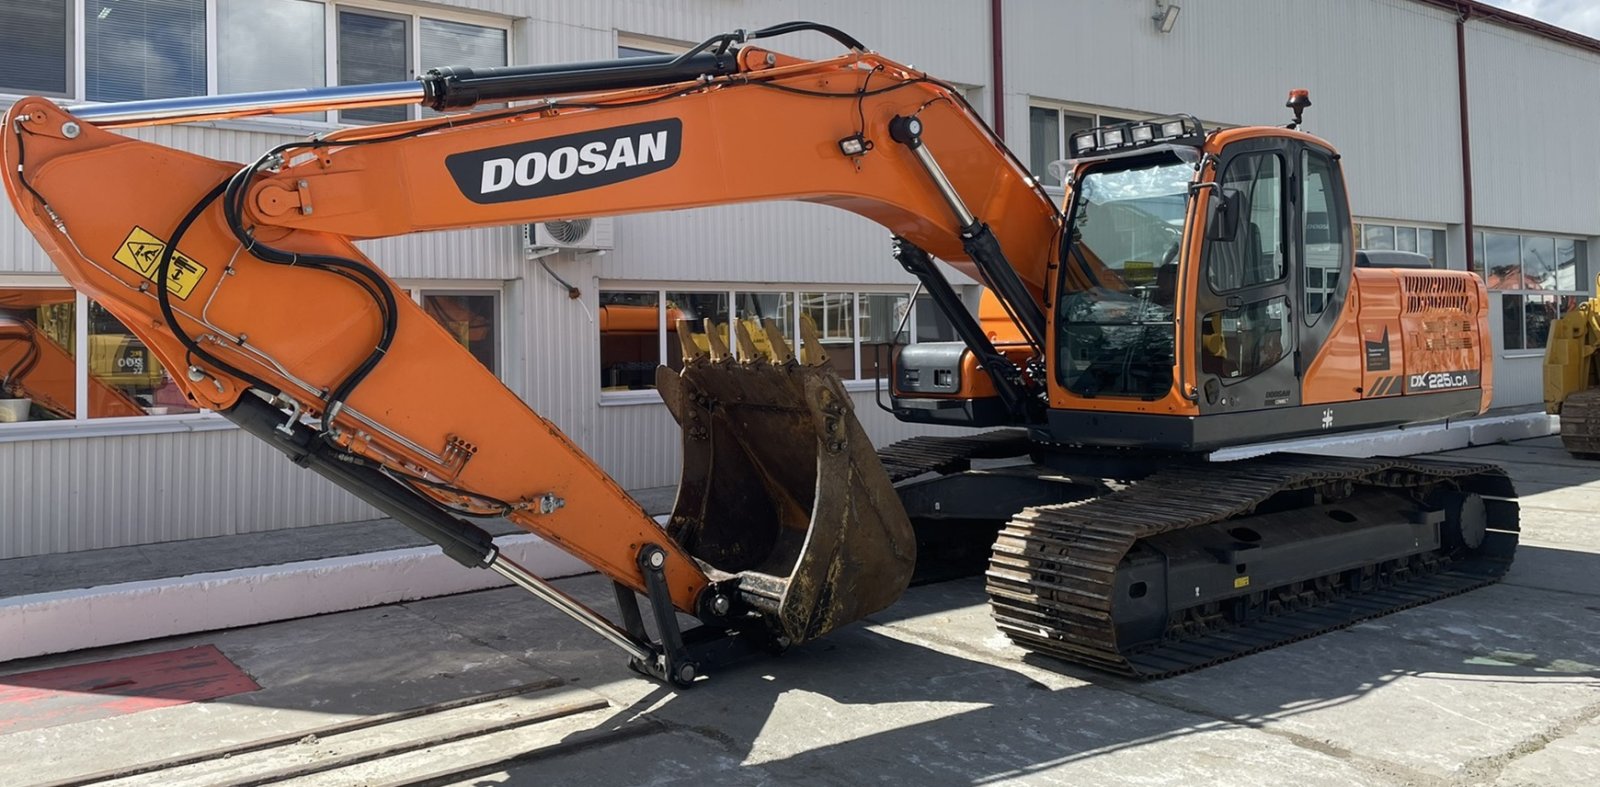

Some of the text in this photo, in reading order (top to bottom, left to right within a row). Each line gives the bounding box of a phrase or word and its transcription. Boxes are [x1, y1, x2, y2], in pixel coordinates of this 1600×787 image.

[480, 130, 668, 194] DOOSAN
[1410, 371, 1468, 388] DX 225LCA
[1265, 390, 1291, 398] DOOSAN
